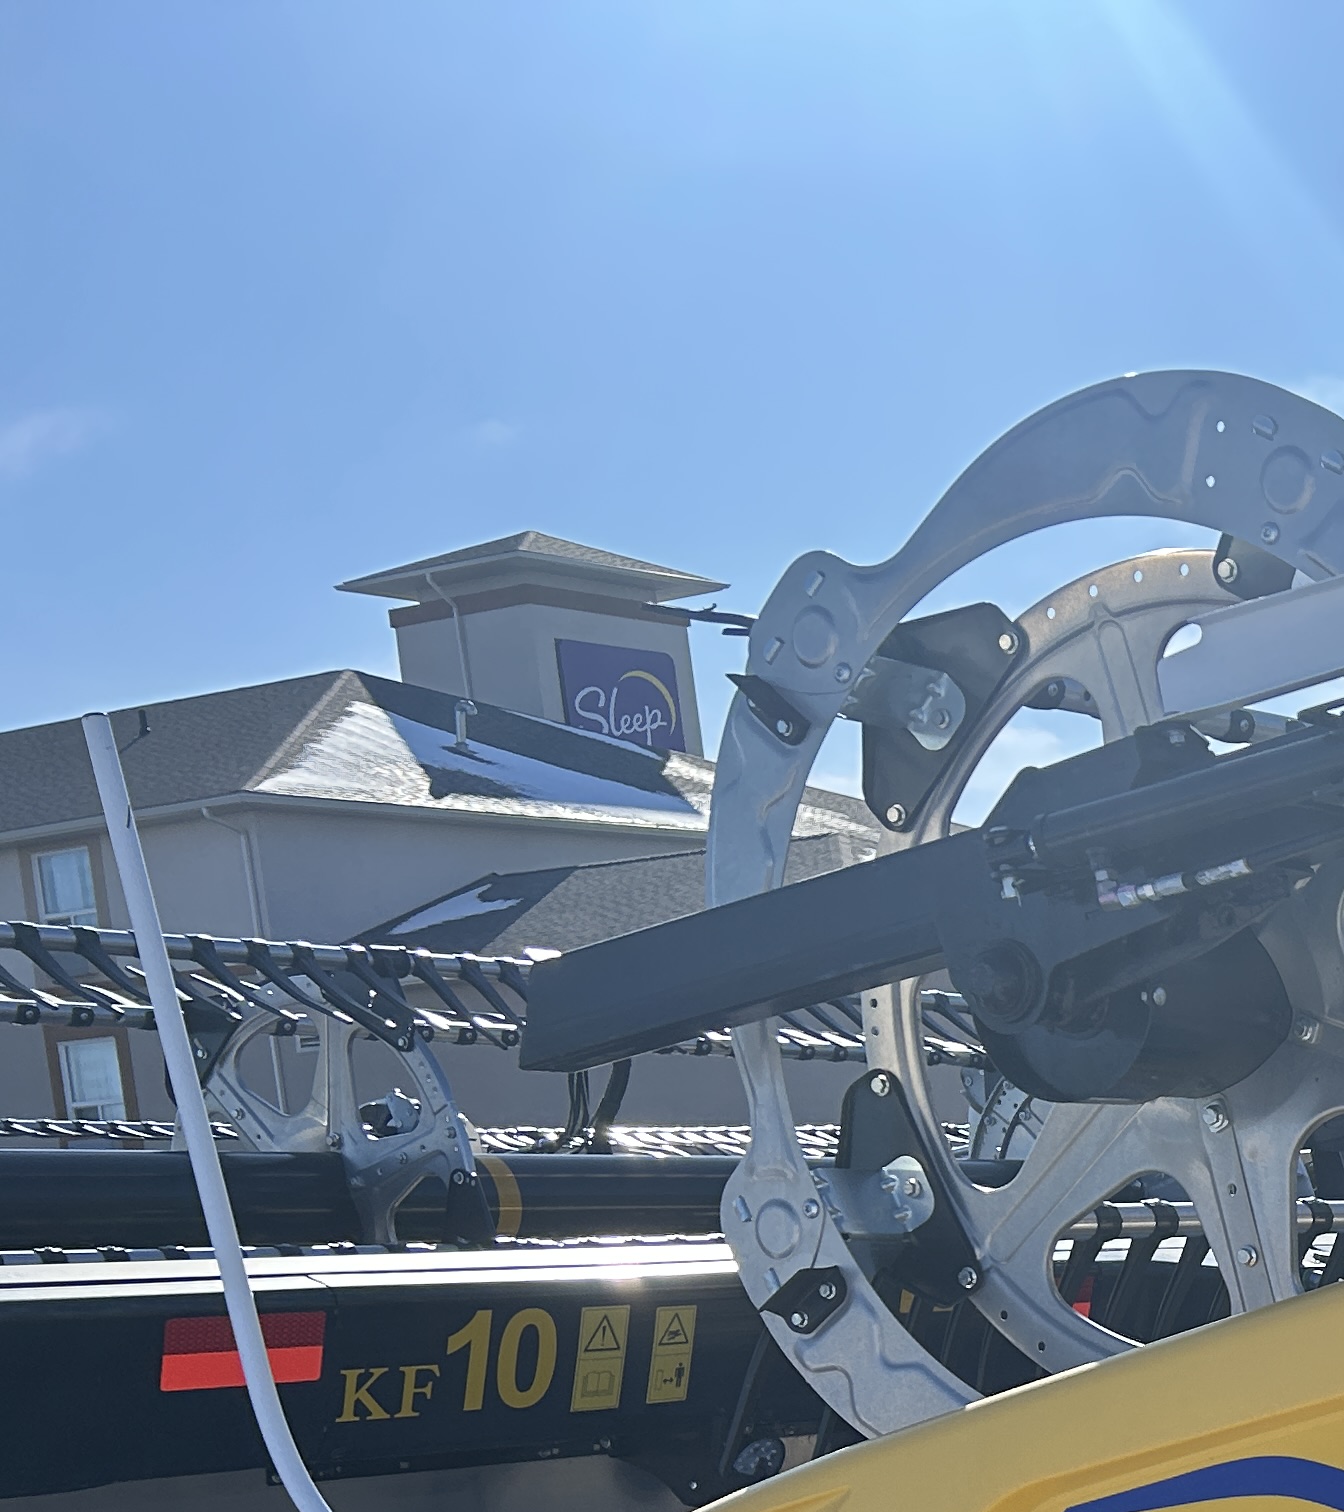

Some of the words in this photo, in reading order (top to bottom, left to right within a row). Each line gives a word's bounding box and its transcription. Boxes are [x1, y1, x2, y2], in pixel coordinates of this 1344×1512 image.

[574, 686, 668, 747] Sleep
[335, 1363, 441, 1424] KF
[446, 1306, 559, 1412] 10
